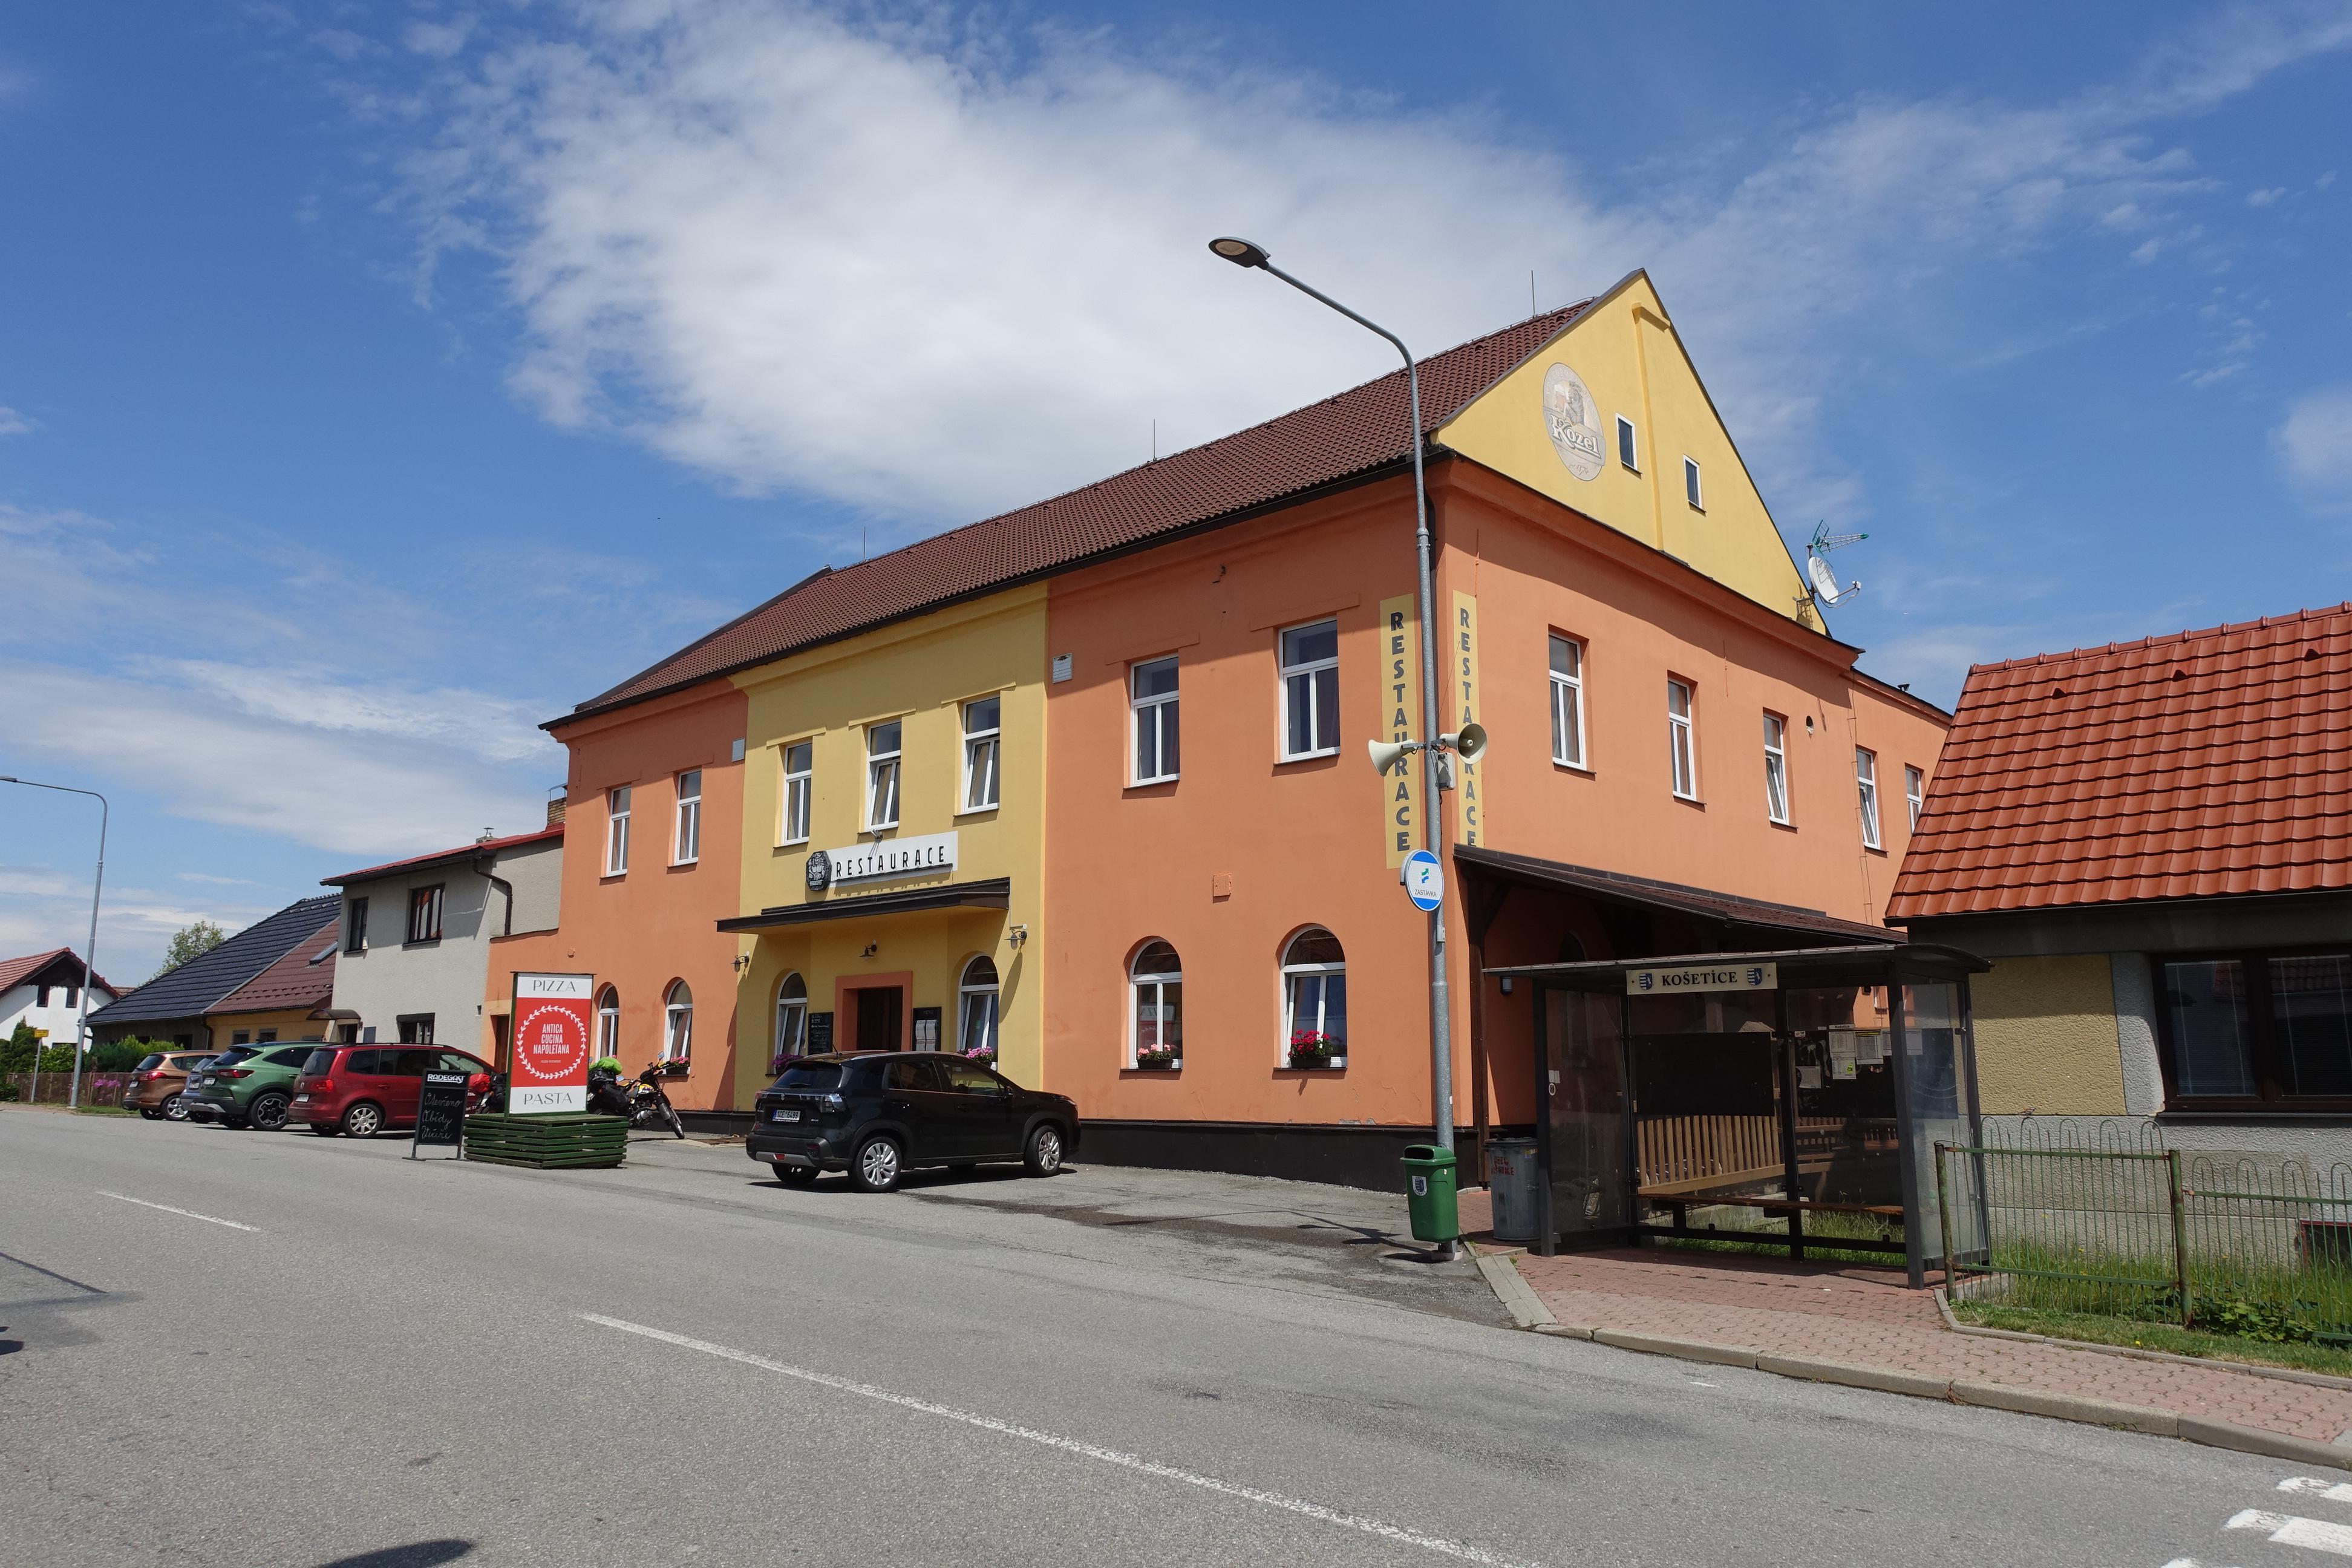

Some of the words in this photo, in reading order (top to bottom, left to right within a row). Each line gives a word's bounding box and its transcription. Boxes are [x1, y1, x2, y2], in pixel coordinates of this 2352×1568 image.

[1550, 413, 1601, 459] Kozel
[1460, 607, 1477, 847] RESTARACE
[836, 846, 944, 877] RESTAURACE
[1414, 889, 1437, 897] ZASTÁVKA
[532, 979, 576, 992] PIZZA
[542, 1024, 563, 1034] ANTICA
[541, 1034, 563, 1044] CUCINA
[533, 1044, 570, 1054] NAPOLETANA
[427, 1074, 465, 1083] RADEGAST
[524, 1093, 572, 1105] PASTA
